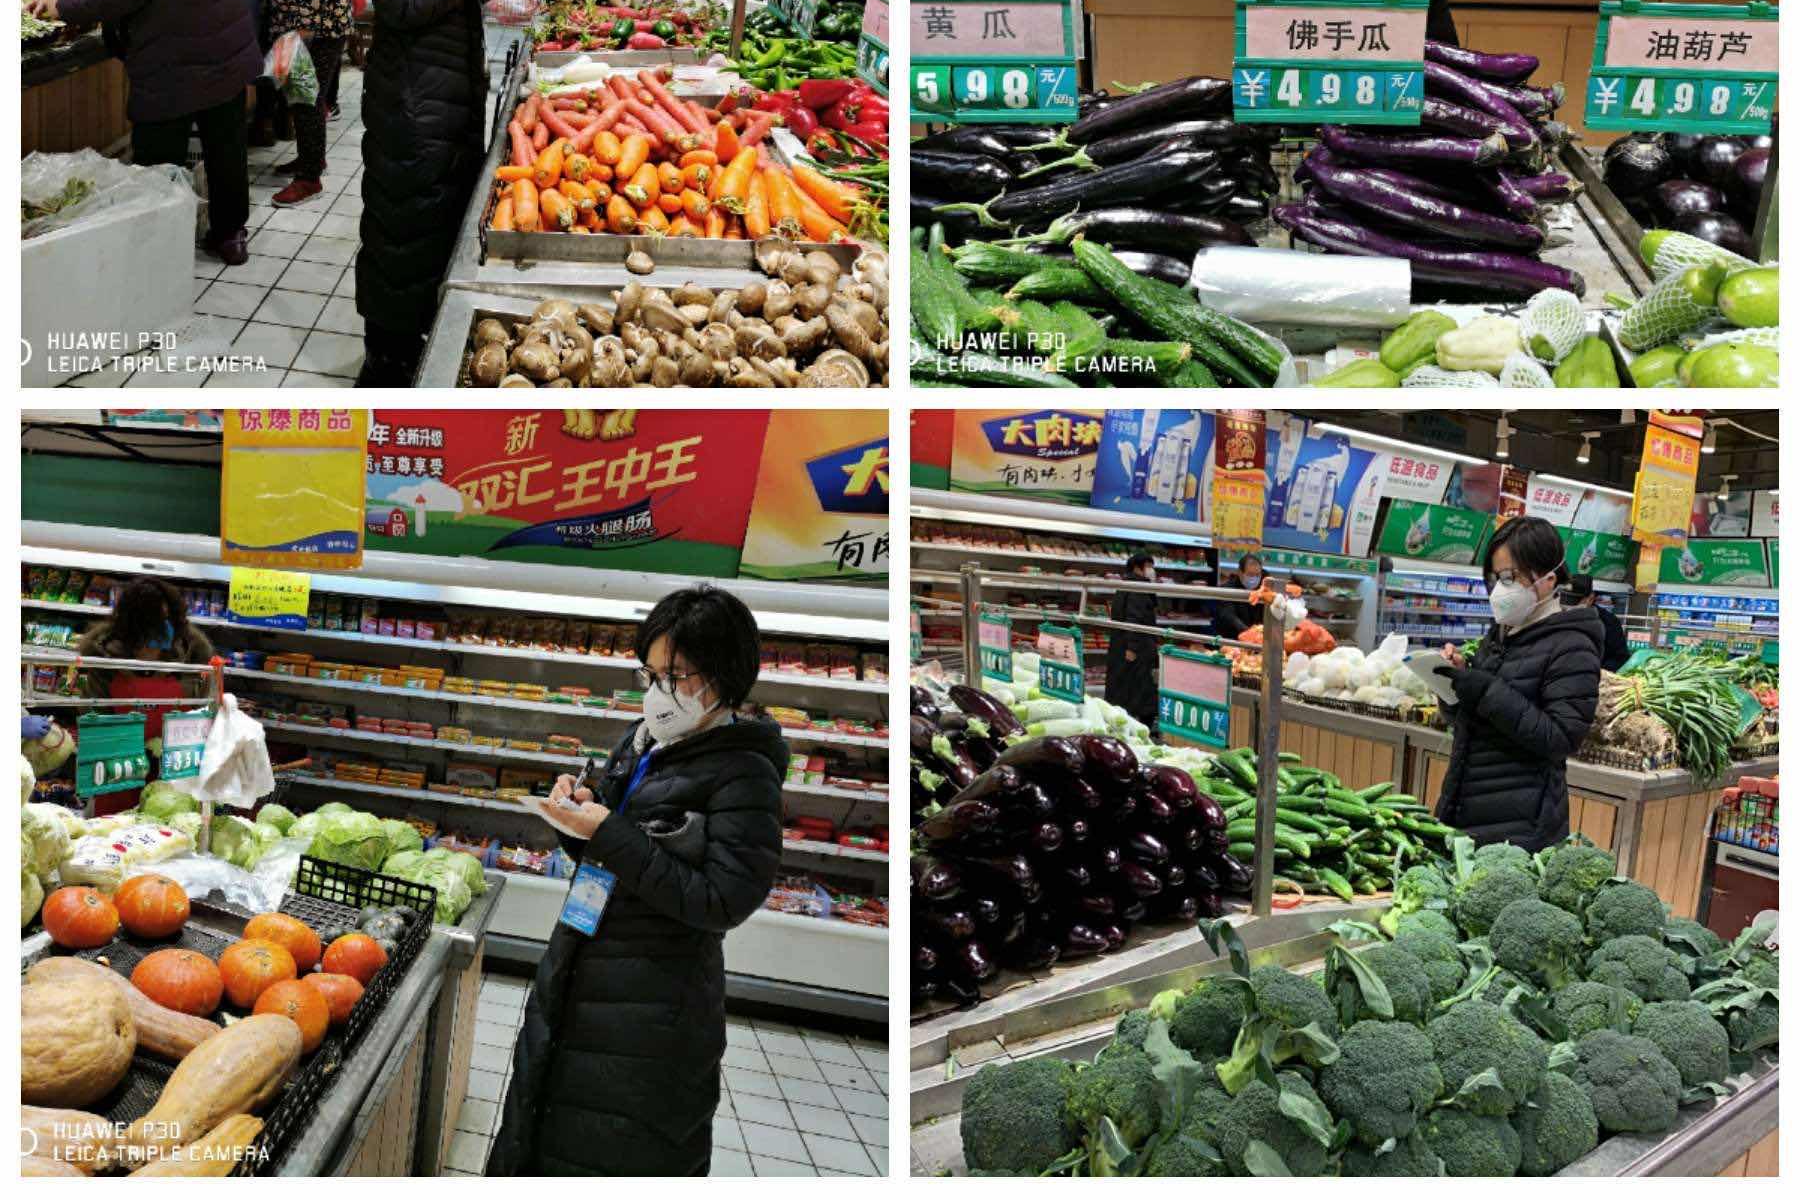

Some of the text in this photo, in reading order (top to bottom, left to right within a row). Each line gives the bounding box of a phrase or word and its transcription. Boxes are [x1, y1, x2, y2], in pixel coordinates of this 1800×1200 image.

[921, 6, 1017, 40] 黄瓜
[1286, 18, 1391, 53] 佛手瓜
[1645, 29, 1753, 61] 油葫芦
[395, 427, 444, 448] 全新升级
[504, 413, 542, 457] 新
[455, 435, 703, 520] 双汇王中王
